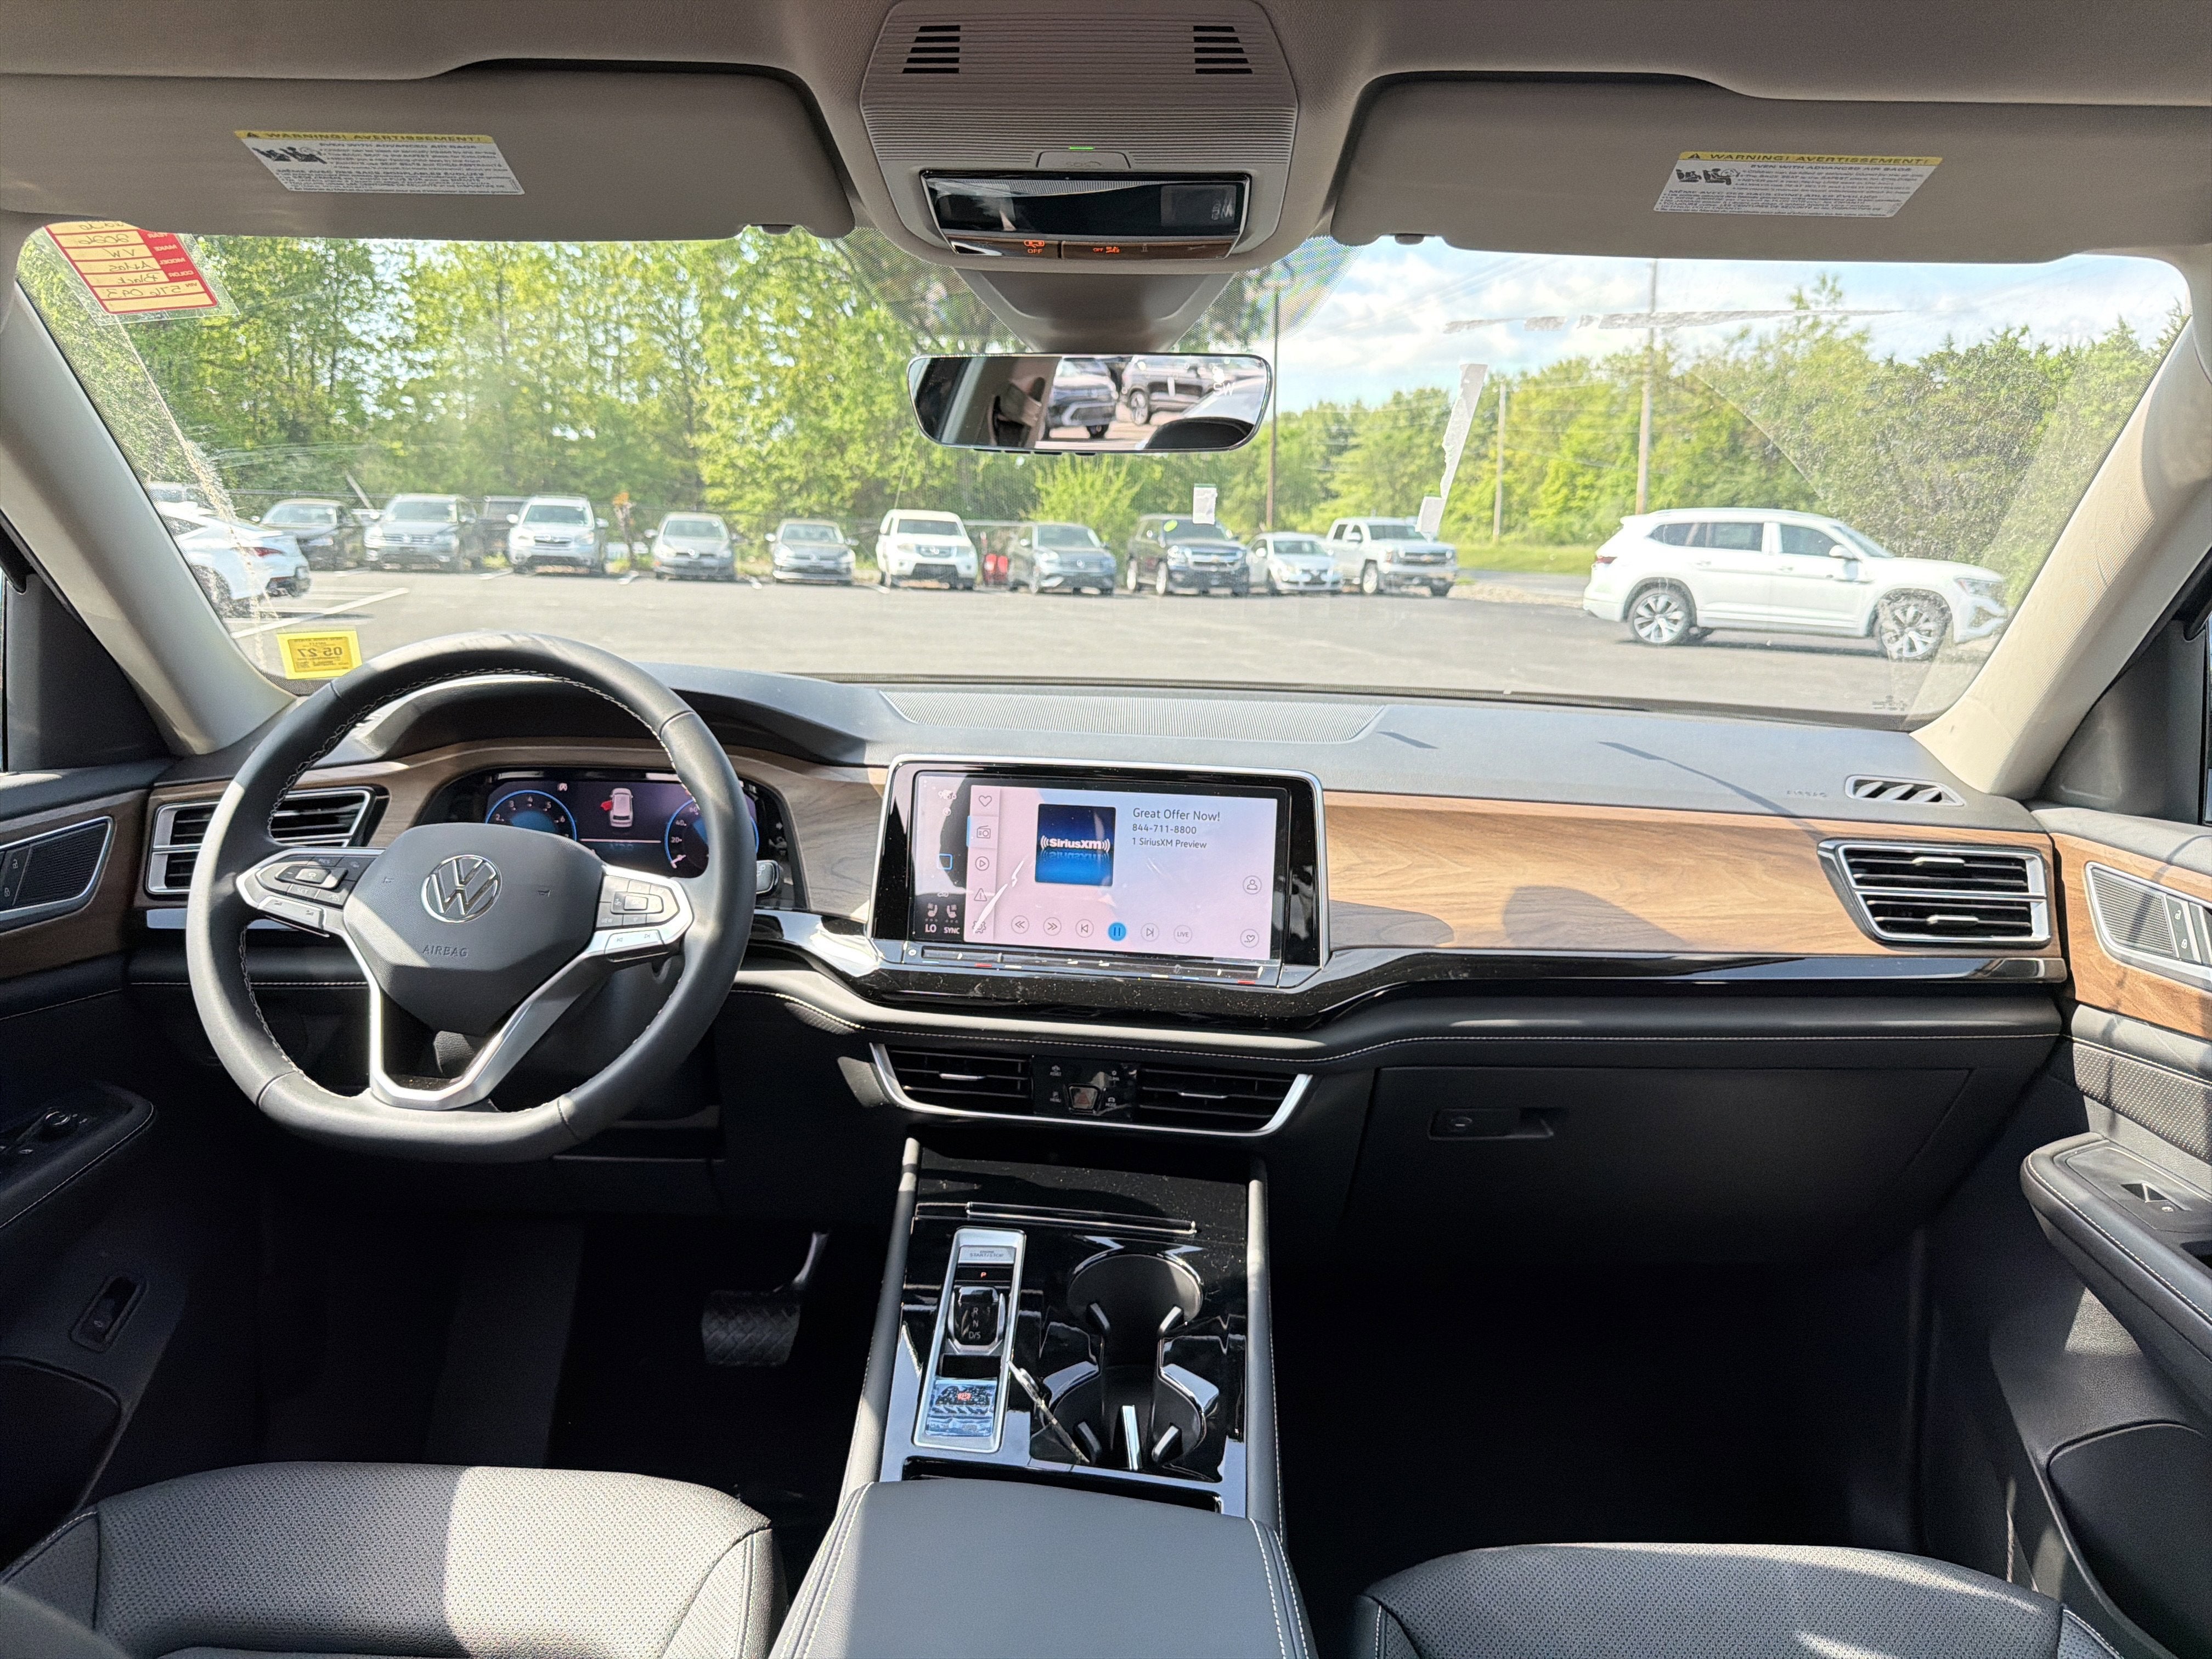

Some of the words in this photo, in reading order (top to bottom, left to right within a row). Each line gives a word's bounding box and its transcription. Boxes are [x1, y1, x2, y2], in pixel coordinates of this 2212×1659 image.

[1213, 382, 1235, 396] SW
[1133, 808, 1161, 819] Great
[1164, 809, 1190, 820] Offer
[1193, 810, 1221, 822] Now!
[1132, 823, 1197, 834] 844-711-8800
[1139, 837, 1173, 847] SiriusXM
[1175, 839, 1207, 849] Preview
[925, 923, 937, 933] LO
[422, 945, 469, 957] AIRBAG
[973, 1307, 979, 1316] R
[973, 1319, 979, 1328] N
[968, 1331, 981, 1339] D/S
